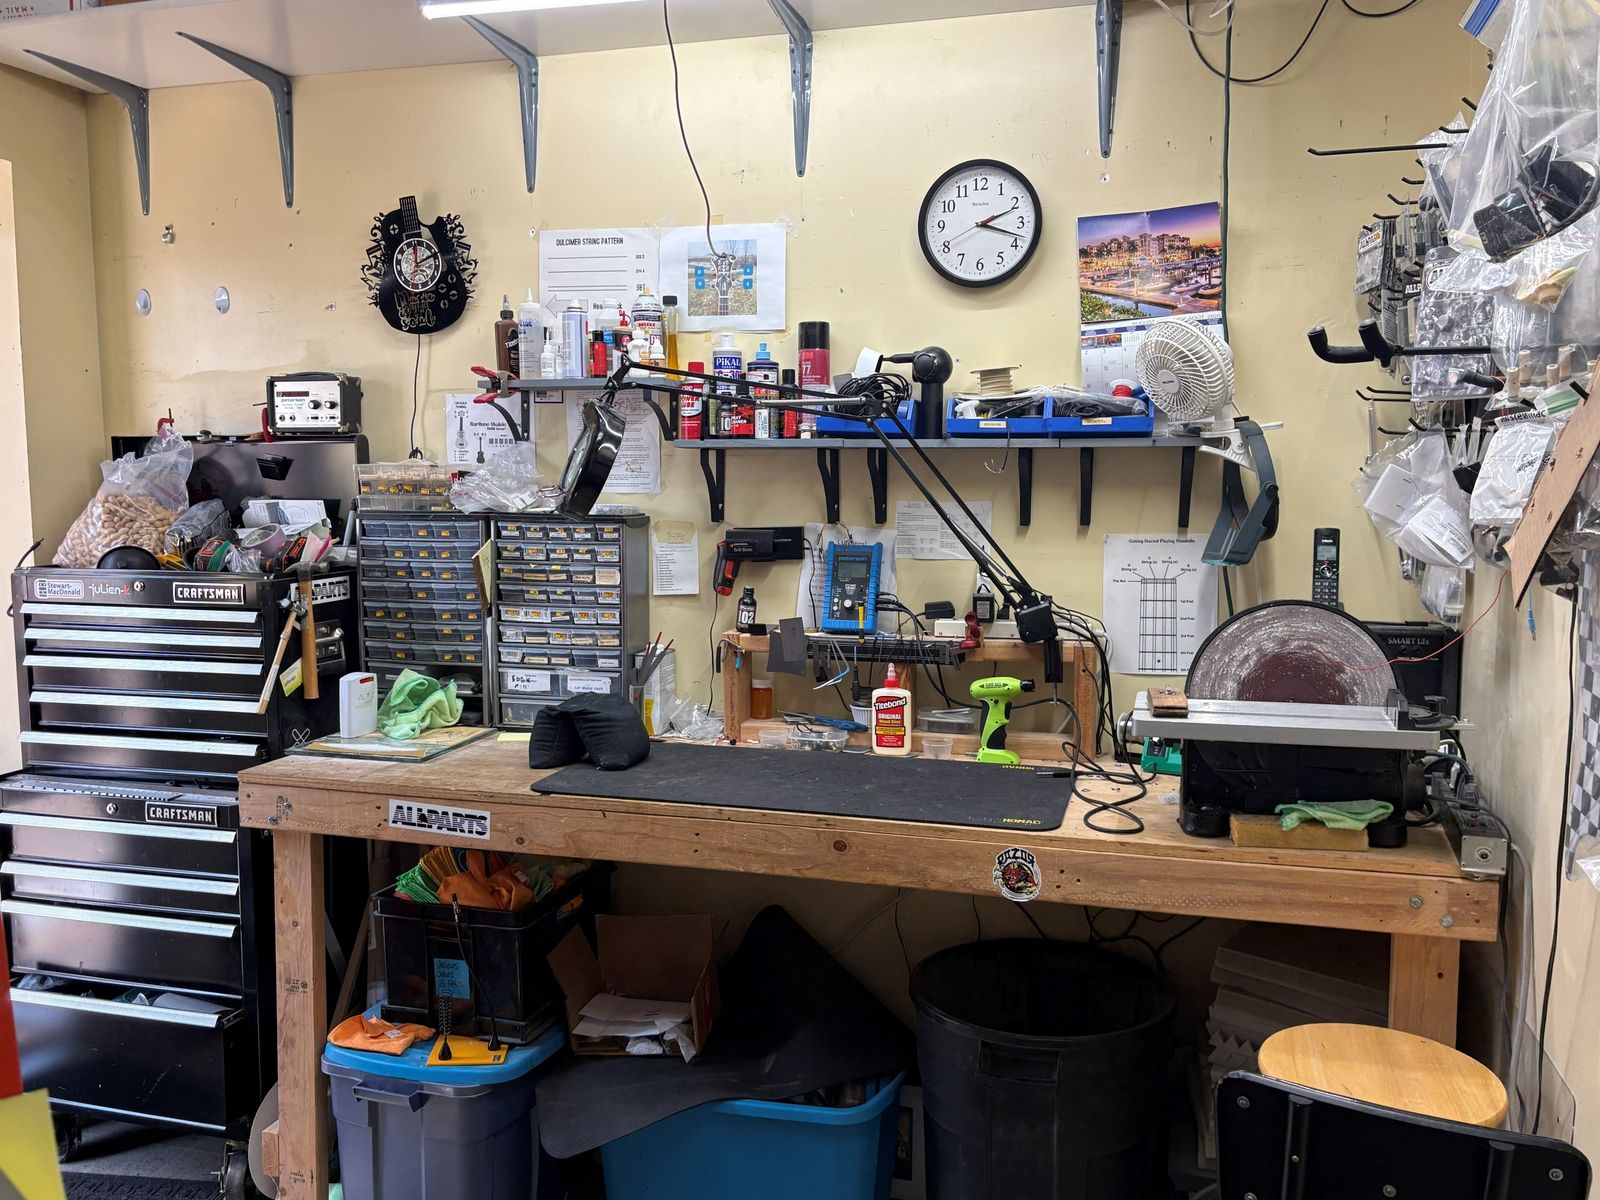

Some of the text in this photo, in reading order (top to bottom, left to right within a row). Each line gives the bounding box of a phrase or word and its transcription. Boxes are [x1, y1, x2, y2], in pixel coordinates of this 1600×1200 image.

[973, 177, 989, 191] 12
[998, 183, 1005, 196] 1
[956, 184, 969, 198] 11
[941, 200, 956, 213] 10
[1011, 196, 1020, 210] 2
[937, 220, 946, 233] 9
[1016, 216, 1025, 229] 3
[555, 238, 581, 247] DULCIMER
[601, 237, 624, 245] PATTERN
[942, 240, 951, 253] 8
[1010, 237, 1019, 250] 4
[957, 253, 965, 266] 7
[976, 258, 984, 271] 6
[996, 251, 1004, 265] 5
[802, 365, 811, 375] 77
[47, 588, 80, 596] MacDonald
[177, 587, 239, 600] CRAFTSMAN
[738, 610, 755, 624] 102
[874, 697, 906, 711] Titebond
[149, 807, 212, 822] CRAFTSMAN
[391, 804, 488, 836] ALLPARTS
